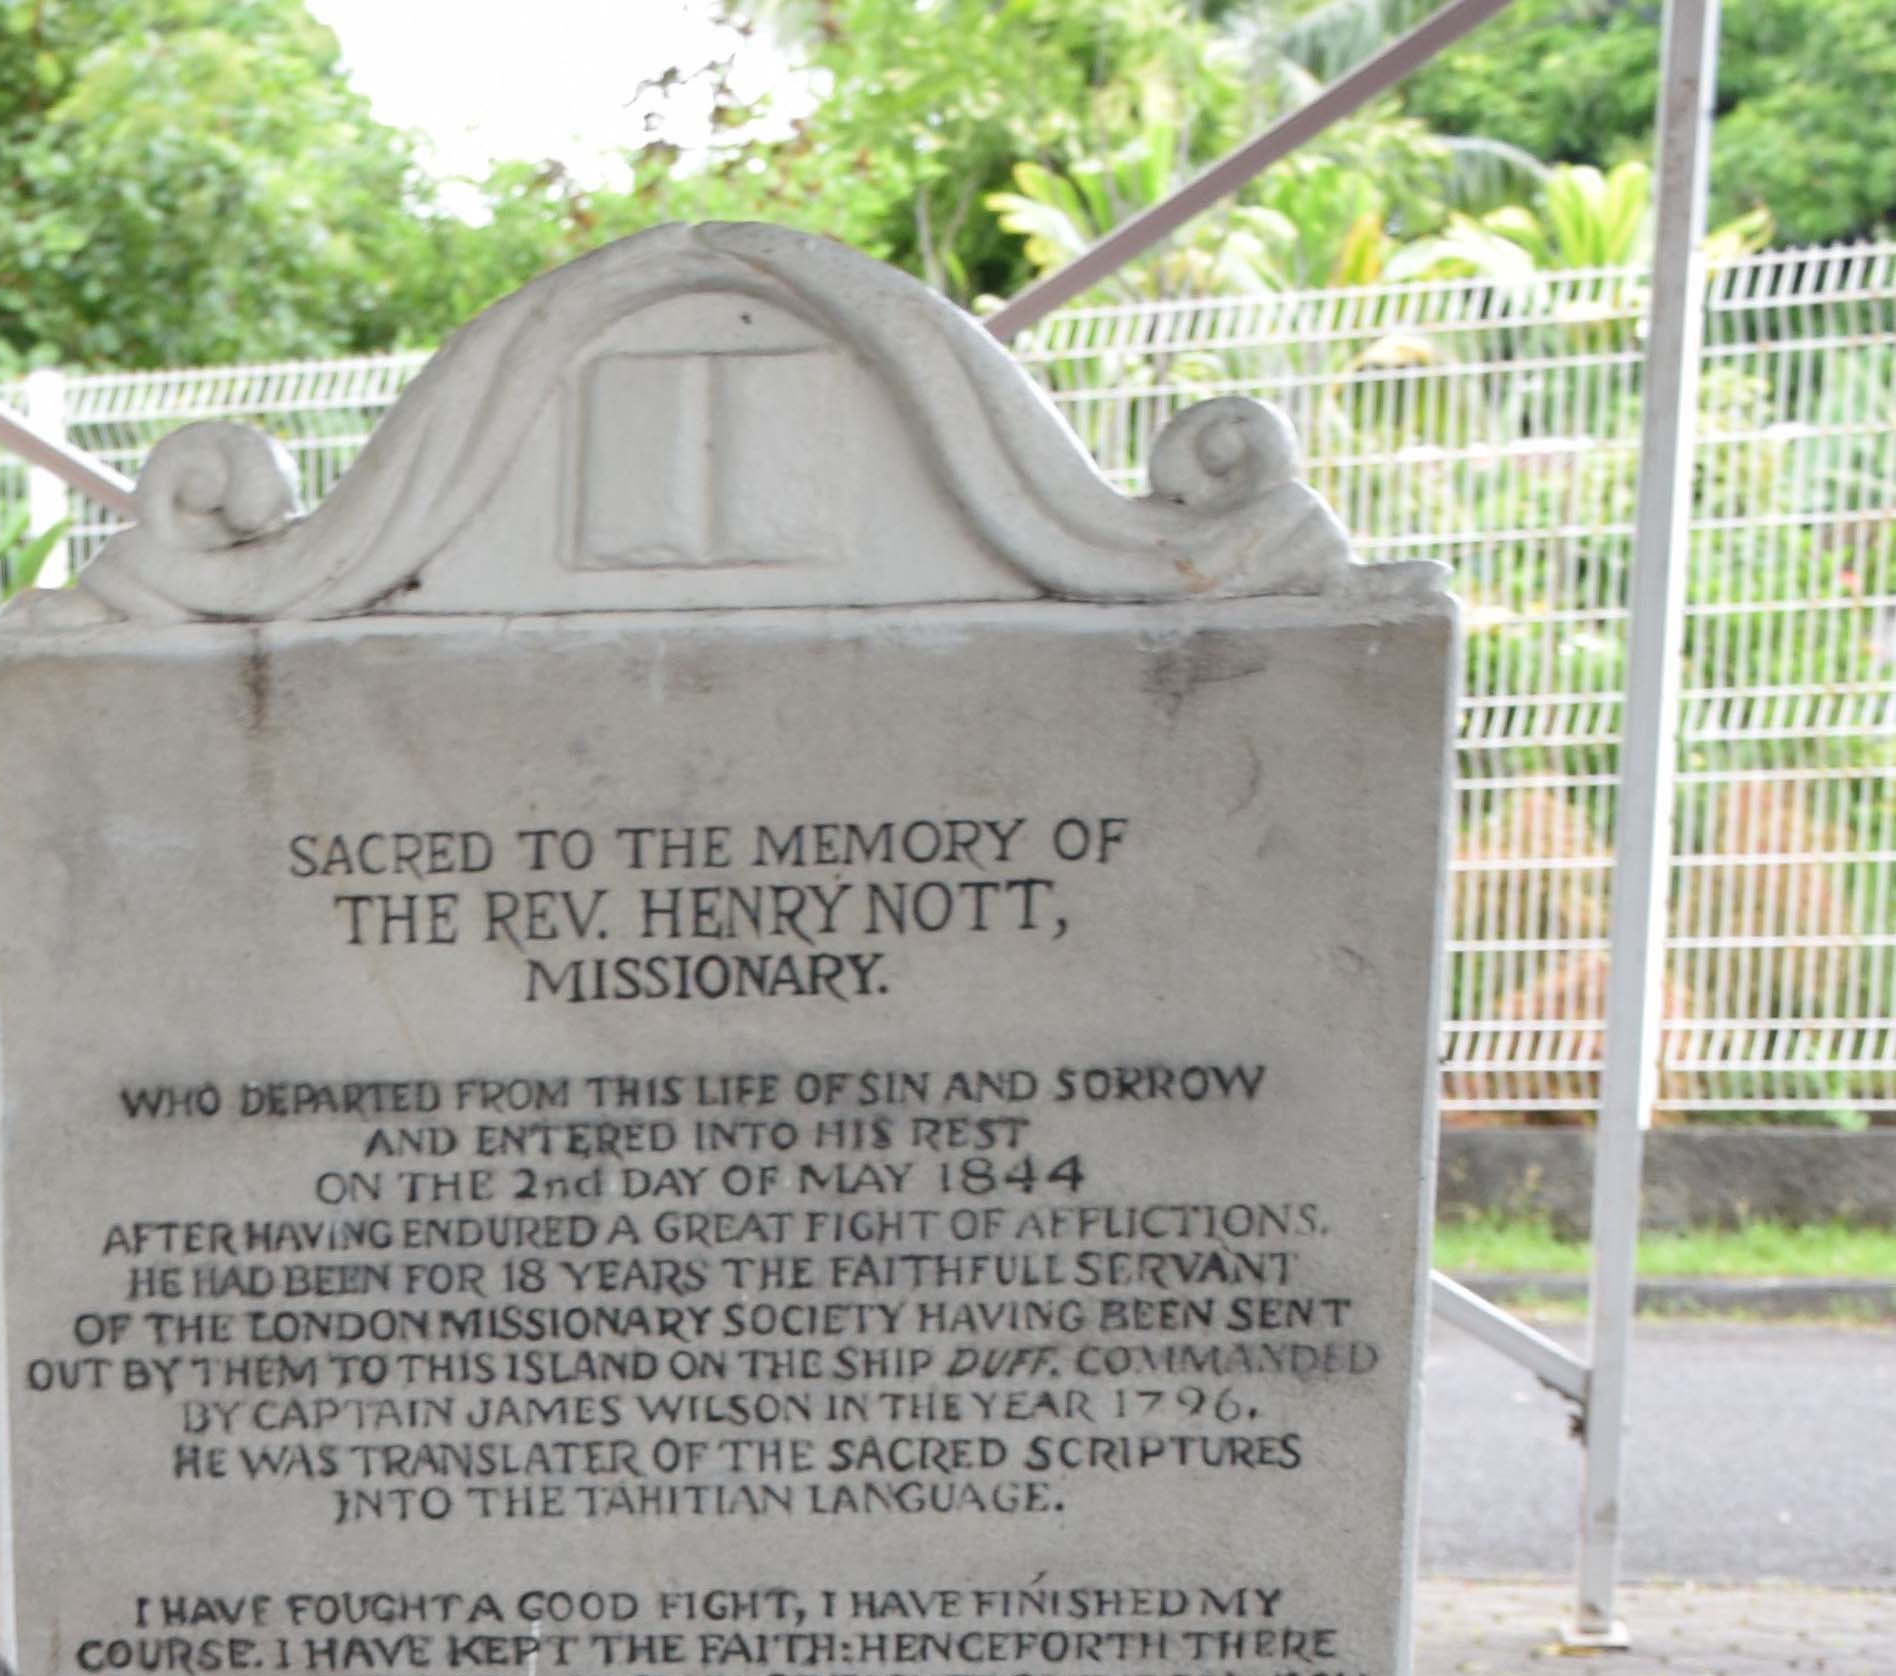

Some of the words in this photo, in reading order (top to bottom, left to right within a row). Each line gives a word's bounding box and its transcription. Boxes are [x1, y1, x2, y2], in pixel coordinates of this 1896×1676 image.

[289, 831, 492, 879] SACRED
[518, 829, 593, 871] TO
[617, 825, 732, 870] THE
[752, 818, 1027, 869] MEMORY
[1053, 818, 1128, 862] OF
[333, 893, 459, 944] THE
[484, 890, 607, 951] REV.
[642, 882, 851, 944] HENRY
[867, 879, 1069, 939] NOTT,
[525, 953, 889, 1002] MISSIONARY.
[120, 1089, 221, 1118] WHO
[239, 1080, 441, 1116] DEPARTED
[455, 1079, 568, 1110] FROM
[585, 1077, 682, 1107] THIS
[698, 1073, 779, 1105] LIFE
[864, 1070, 929, 1102] SIN
[944, 1069, 1037, 1101] AND
[1056, 1065, 1266, 1102] SORROW
[364, 1127, 457, 1157] AND
[476, 1122, 677, 1157] ENTERED
[695, 1121, 797, 1152] INTO
[815, 1117, 892, 1150] HIS
[911, 1115, 1029, 1149] REST
[315, 1172, 381, 1204] ON
[399, 1171, 494, 1201] THE
[513, 1168, 602, 1200] 2nd
[622, 1165, 706, 1198] DAY
[722, 1164, 778, 1197] OF
[799, 1161, 912, 1196] MAY
[940, 1154, 1085, 1194] 1844
[102, 1222, 239, 1256] AFTER
[245, 1218, 394, 1252] HAVING
[405, 1214, 599, 1250] ENDURED
[654, 1211, 794, 1248] GREAT
[807, 1211, 942, 1243] FIGHT
[950, 1208, 1008, 1240] OF
[1015, 1203, 1330, 1240] AFFLICTIONS.
[405, 1262, 486, 1297] FOR
[505, 1259, 545, 1293] 18
[560, 1256, 708, 1296] YEARS
[722, 1256, 813, 1290] THE
[831, 1253, 1064, 1288] FAITHFULL
[1074, 1251, 1299, 1288] SERVANT
[74, 1313, 131, 1346] OF
[144, 1313, 232, 1345] THE
[249, 1309, 427, 1342] LONDON
[440, 1304, 714, 1342] MISSIONARY
[722, 1302, 905, 1337] SOCIETY
[919, 1300, 1085, 1334] HAVING
[1100, 1299, 1216, 1331] BEEN
[1226, 1298, 1351, 1331] SENT
[28, 1358, 112, 1391] OUT
[124, 1357, 183, 1393] BY
[192, 1355, 319, 1388] THEM
[329, 1355, 387, 1385] TO
[399, 1352, 495, 1385] THIS
[508, 1350, 659, 1385] ISLAND
[670, 1350, 726, 1381] ON
[738, 1349, 822, 1380] THE
[832, 1348, 933, 1380] SHIP
[253, 1399, 454, 1430] CAPTAIN
[467, 1396, 622, 1428] JAMES
[636, 1393, 812, 1426] WILSON
[970, 1389, 1096, 1421] YEAR
[1114, 1386, 1259, 1422] 1796.
[239, 1444, 339, 1479] WAS
[350, 1440, 645, 1477] TRANSLATER
[653, 1438, 709, 1474] OF
[716, 1438, 815, 1473] THE
[827, 1435, 1009, 1474] SACRED
[1024, 1433, 1304, 1472] SCRIPTURES
[334, 1488, 452, 1525] INTO
[466, 1486, 568, 1516] THE
[575, 1484, 794, 1516] TAHITIAN
[809, 1481, 1064, 1514] LANGUAGE.
[162, 1595, 272, 1626] HAVE
[285, 1592, 464, 1625] FOUGHT
[517, 1591, 639, 1622] GOOD
[659, 1590, 806, 1625] FIGHT,
[851, 1590, 962, 1618] HAVE
[974, 1587, 1187, 1617] FINISHED
[1201, 1587, 1282, 1617] MY
[77, 1637, 263, 1676] COURSE.
[304, 1636, 431, 1668] HAVE
[447, 1633, 582, 1667] KEPT
[591, 1634, 686, 1666] THE
[859, 1631, 1166, 1665] HENCEFORTH
[1182, 1628, 1338, 1663] THERE
